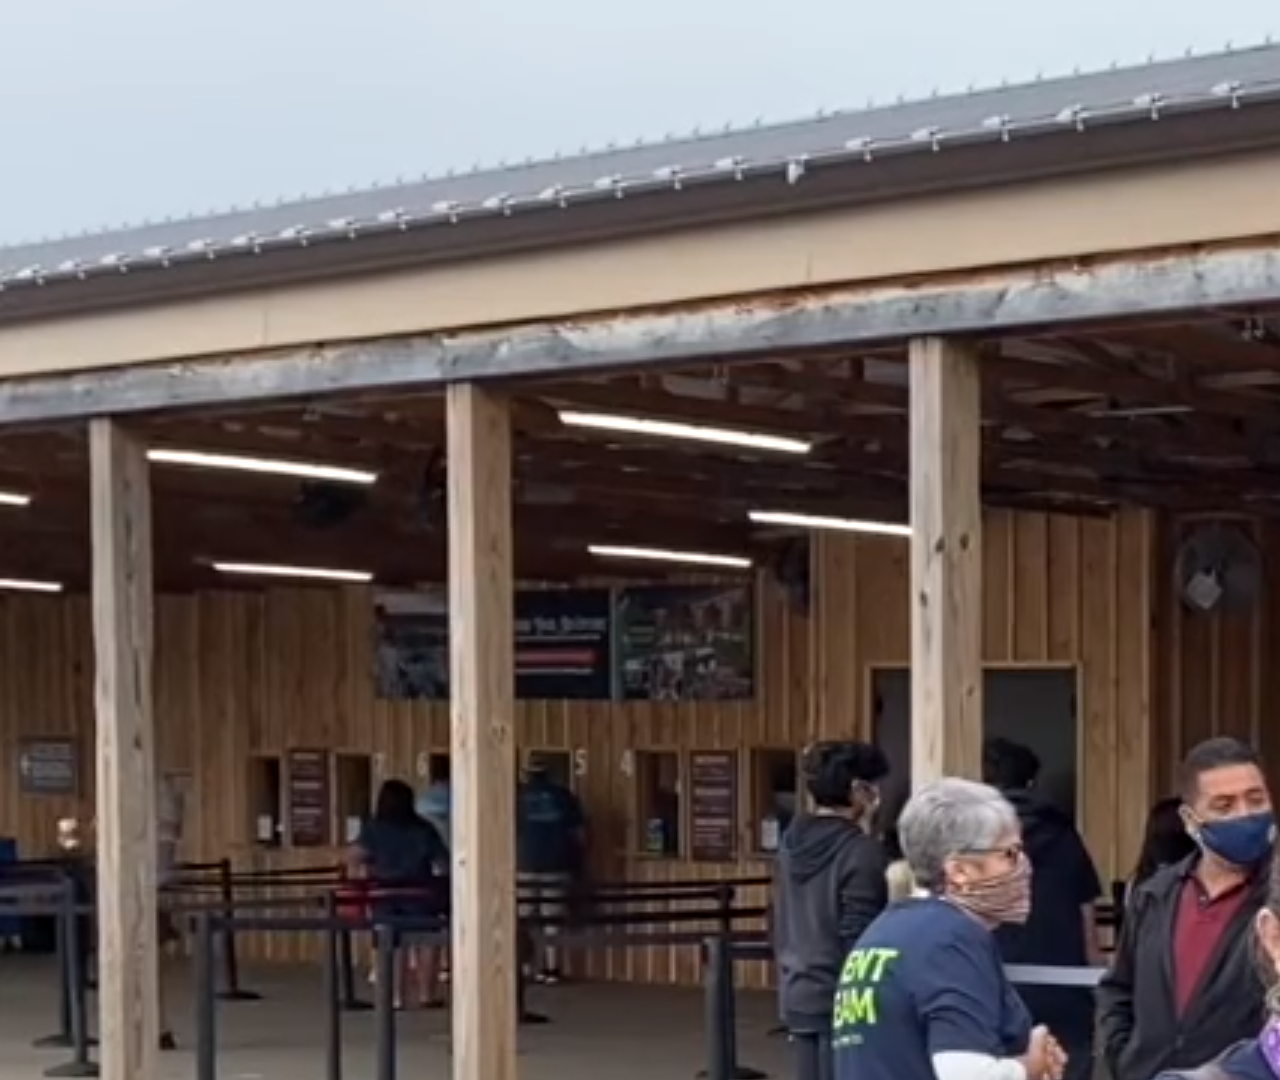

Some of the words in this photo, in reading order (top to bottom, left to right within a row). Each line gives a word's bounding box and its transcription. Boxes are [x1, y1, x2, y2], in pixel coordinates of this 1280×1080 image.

[575, 749, 588, 775] 5
[841, 948, 899, 983] ENT
[832, 986, 877, 1029] EAM
